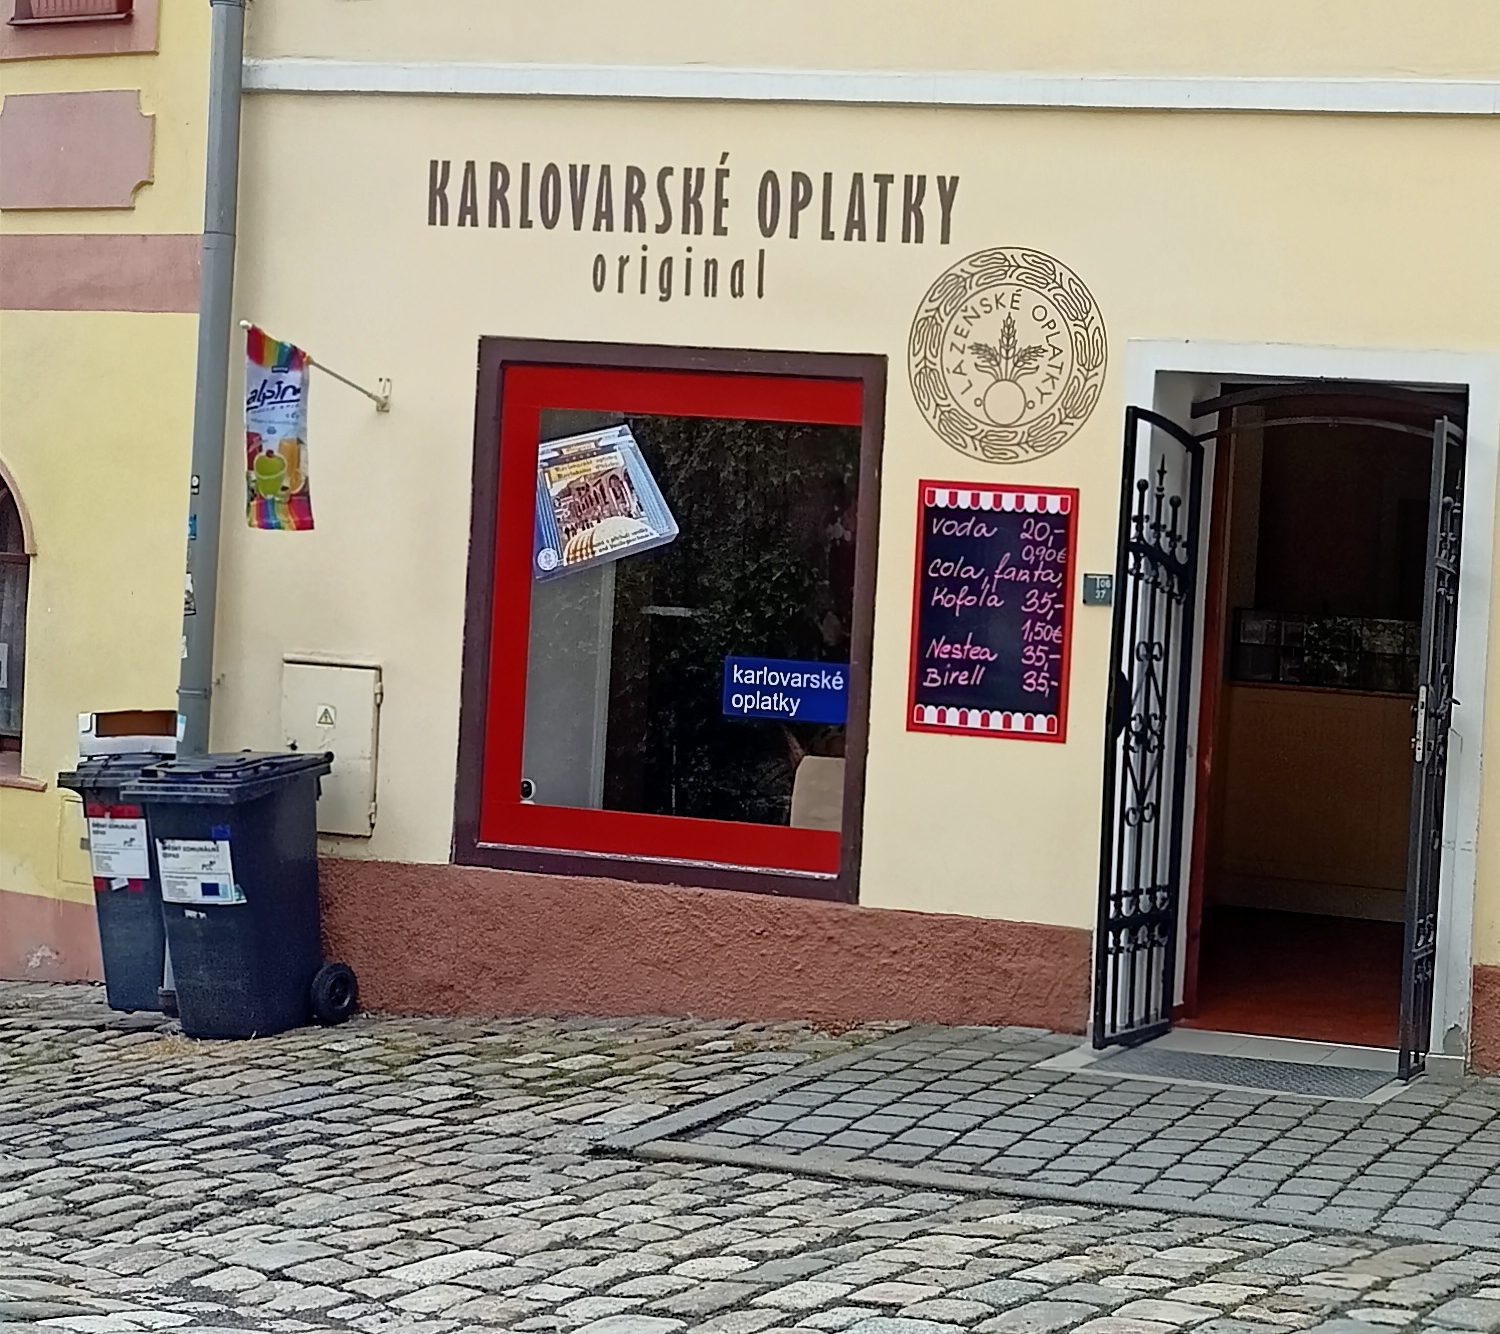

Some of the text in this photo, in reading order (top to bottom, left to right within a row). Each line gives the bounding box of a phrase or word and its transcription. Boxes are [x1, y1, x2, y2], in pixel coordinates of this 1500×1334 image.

[428, 152, 959, 245] KARLOVARSKÉ OPLATKY
[592, 247, 766, 303] original
[946, 289, 1064, 404] LÁZEŇSKÉ OPLATKY
[925, 631, 999, 662] Nestea
[732, 664, 845, 691] karlovarské
[923, 663, 987, 688] Birell
[731, 690, 802, 717] oplatky
